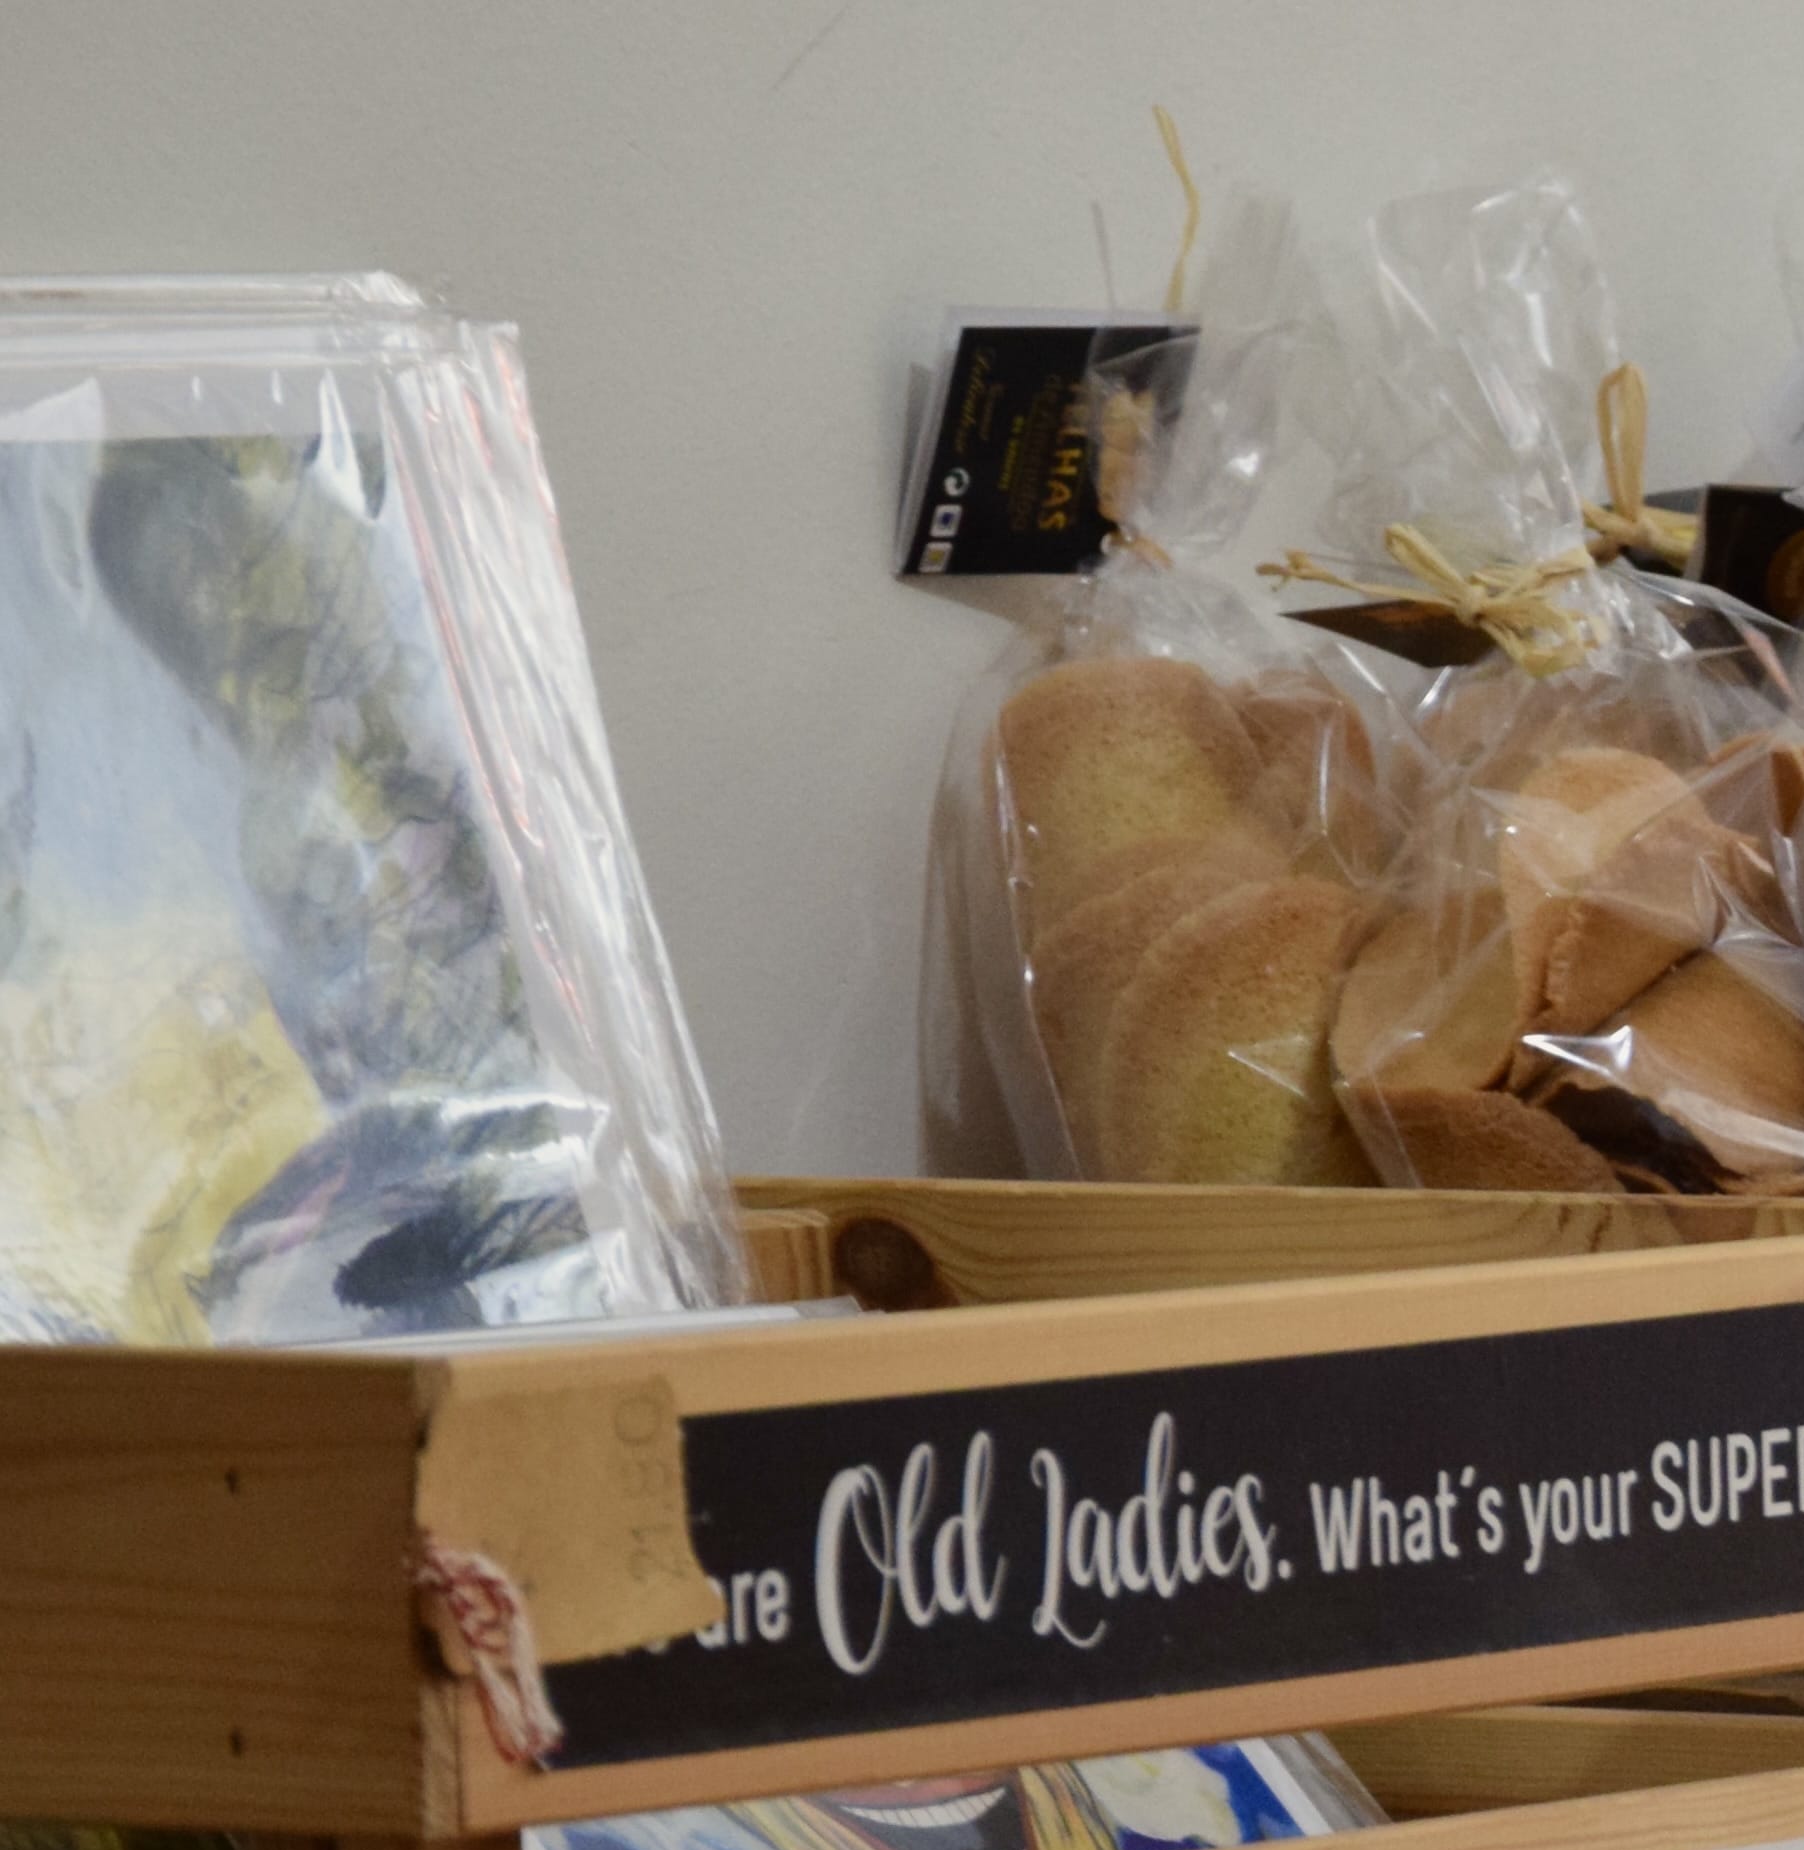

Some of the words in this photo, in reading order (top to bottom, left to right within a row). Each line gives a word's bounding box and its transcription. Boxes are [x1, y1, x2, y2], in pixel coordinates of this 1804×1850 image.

[814, 1430, 1007, 1675] Old
[1029, 1410, 1293, 1649] Ladies.
[1518, 1469, 1637, 1574] your
